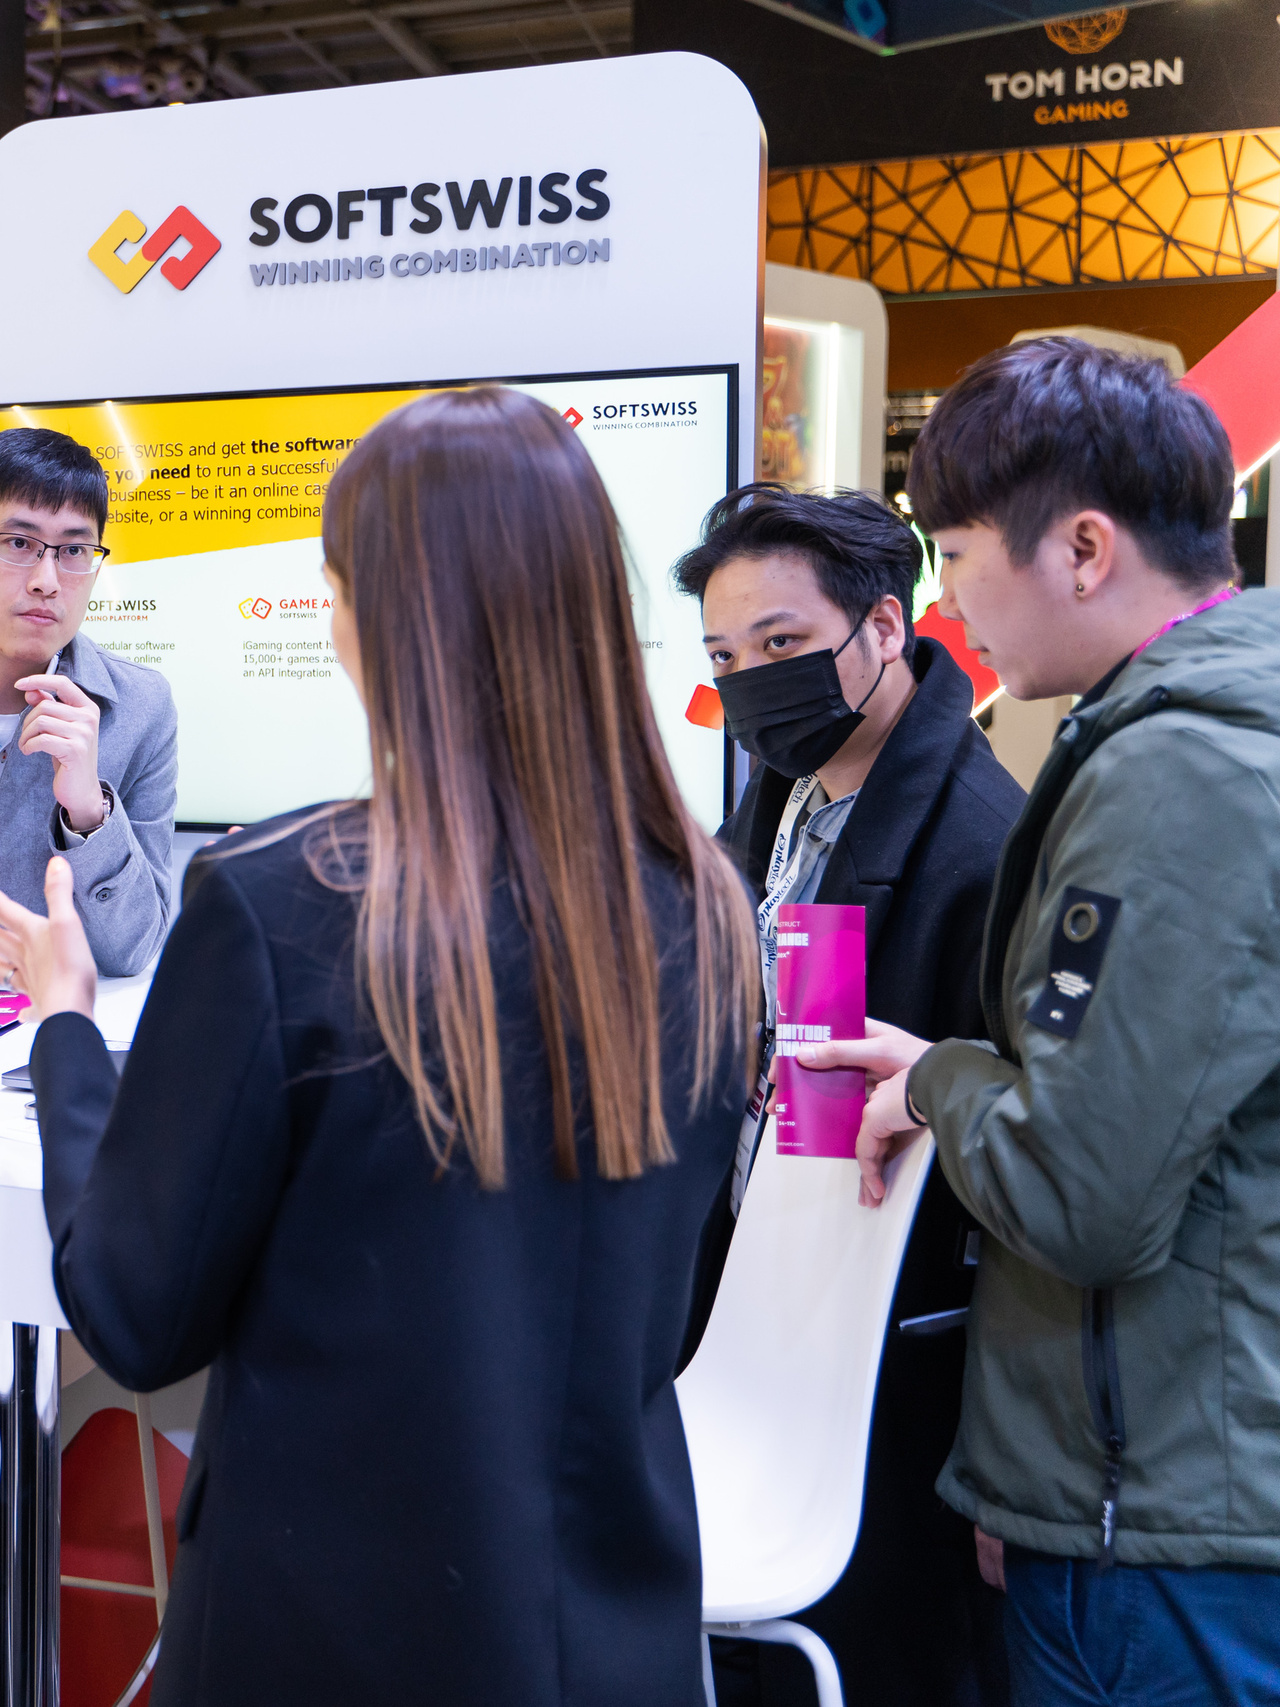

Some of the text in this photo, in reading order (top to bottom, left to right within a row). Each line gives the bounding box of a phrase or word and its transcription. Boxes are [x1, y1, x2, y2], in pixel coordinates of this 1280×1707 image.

[985, 56, 1184, 101] TOM HORN
[1033, 99, 1130, 125] GAMING
[248, 168, 611, 247] SOFTSWISS
[249, 237, 611, 287] WINNING COMBINATION
[593, 401, 697, 419] SOFTSWISS
[593, 420, 698, 431] WINNING COMBINATION
[95, 443, 183, 460] SOFSWISS
[188, 441, 216, 457] and
[221, 441, 246, 459] get
[251, 439, 280, 454] the
[150, 464, 190, 480] need
[196, 464, 211, 478] to
[216, 465, 241, 477] run
[247, 465, 256, 476] a
[261, 458, 339, 476] successful
[109, 488, 171, 502] business
[191, 485, 209, 500] be
[214, 485, 224, 499] it
[229, 487, 247, 498] an
[253, 482, 298, 498] online
[159, 510, 174, 522] or
[179, 510, 188, 521] a
[193, 506, 251, 524] winning
[257, 504, 324, 520] combina
[279, 598, 318, 610] GAME
[135, 640, 175, 651] software
[243, 640, 282, 652] iGaming
[285, 641, 322, 650] content
[134, 654, 162, 664] online
[244, 654, 283, 665] 15,000+
[287, 656, 320, 666] games
[243, 668, 331, 680] an API integration
